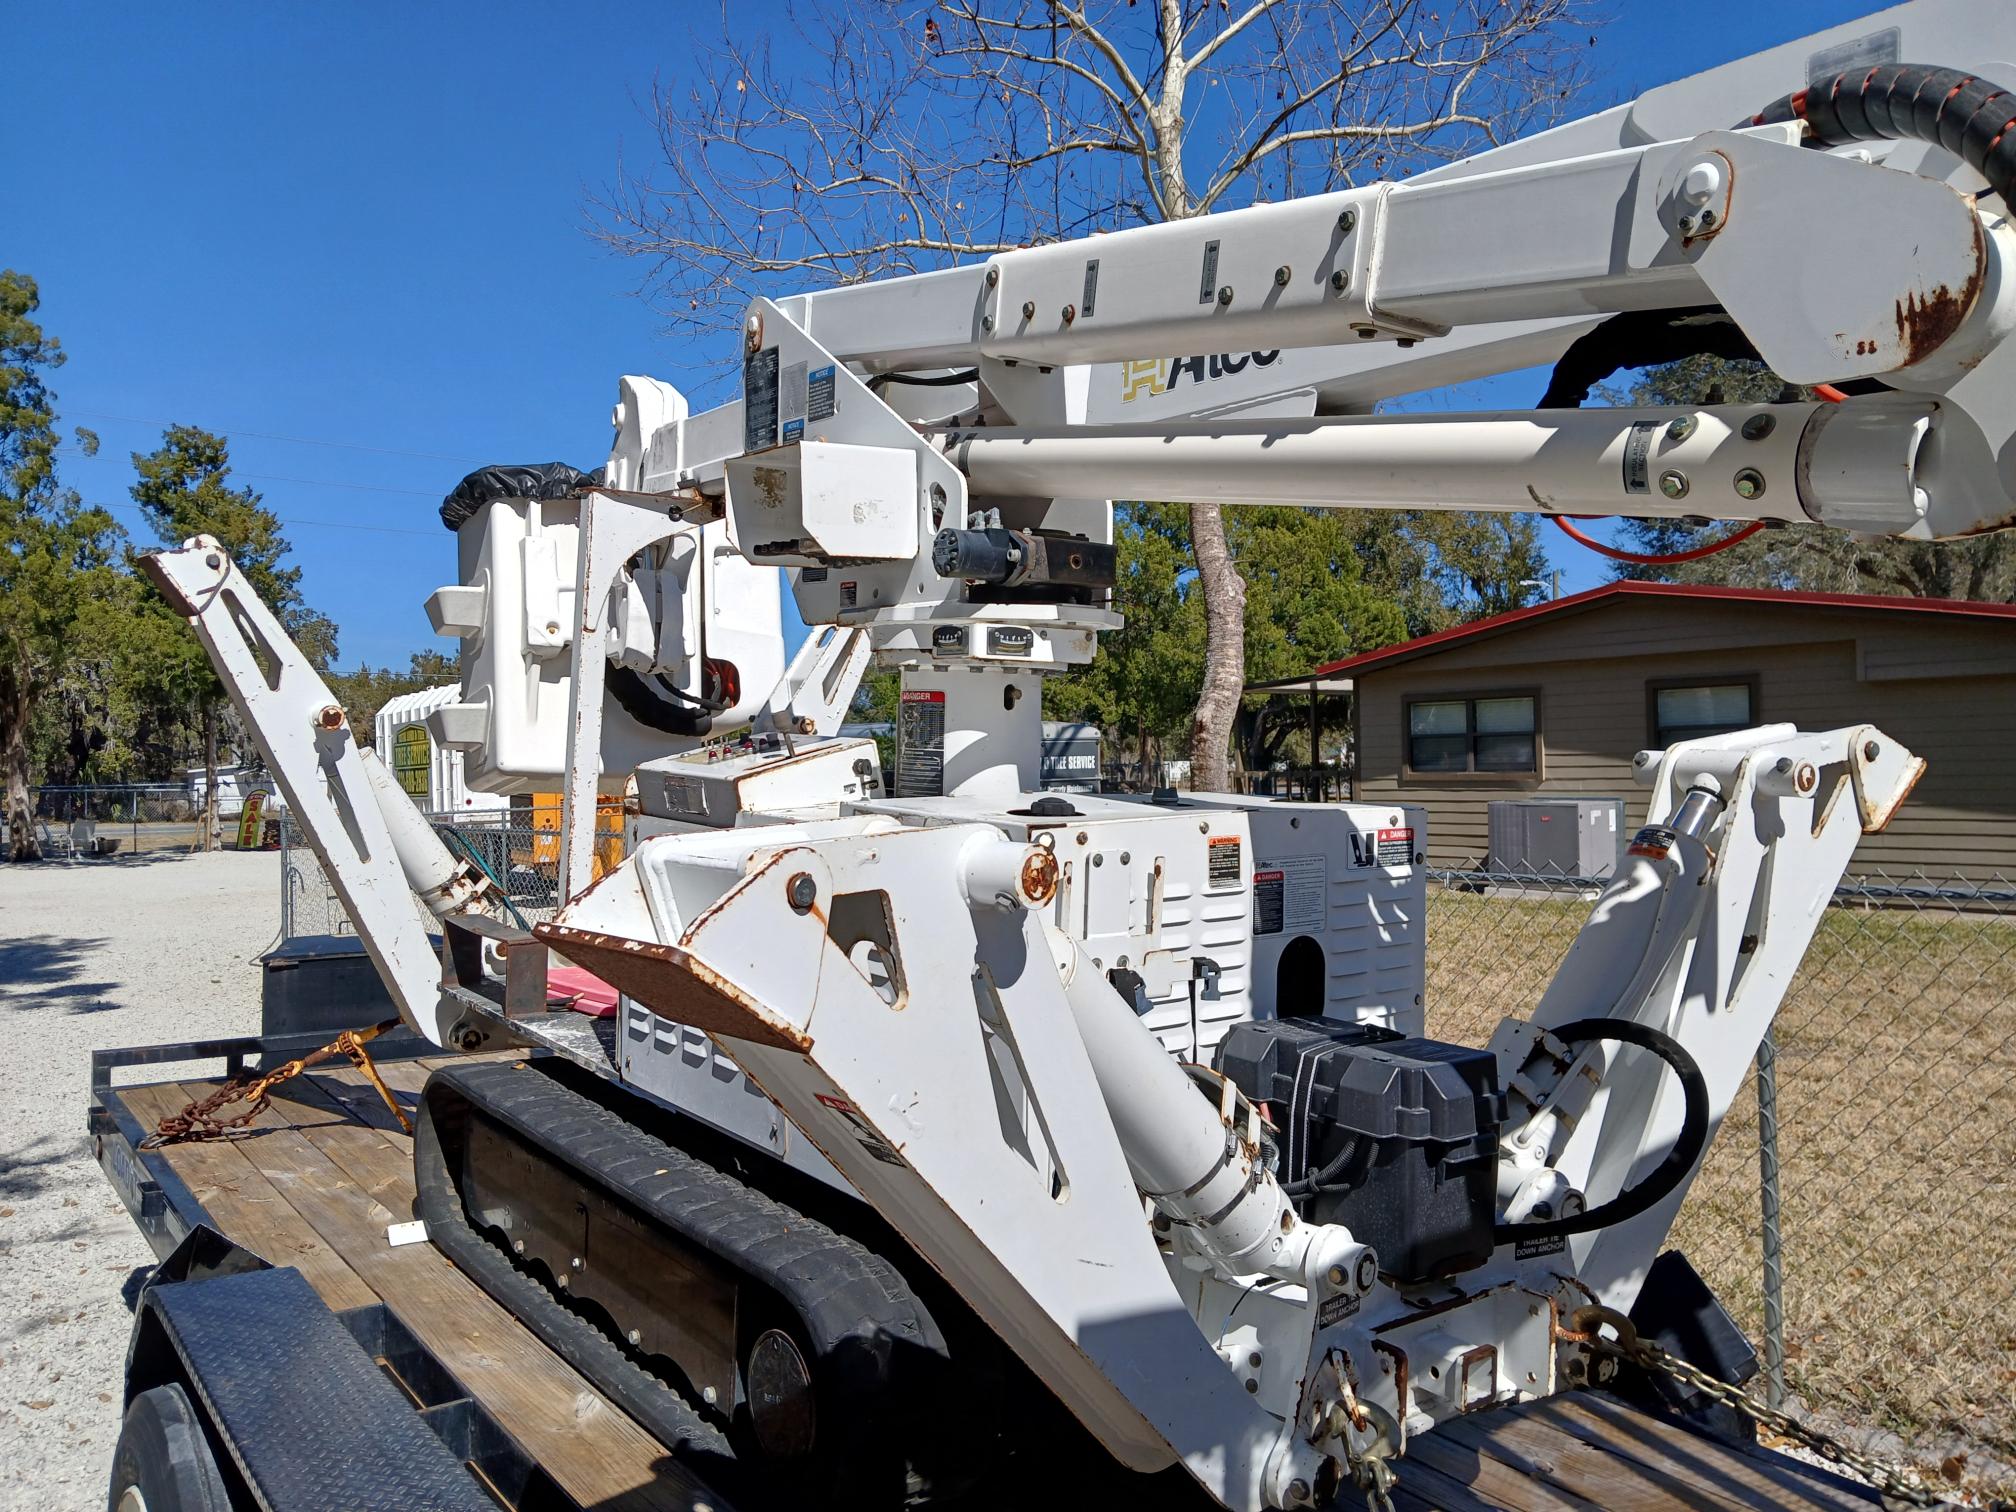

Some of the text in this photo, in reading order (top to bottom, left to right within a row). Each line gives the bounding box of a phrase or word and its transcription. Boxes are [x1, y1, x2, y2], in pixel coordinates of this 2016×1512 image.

[1068, 756, 1096, 769] SERVICE
[242, 800, 258, 846] SALE
[1390, 830, 1412, 839] DANGER
[1516, 1241, 1564, 1257] DOWN ANCHOR
[1320, 1300, 1360, 1325] DOWN ANCHOR
[1325, 1296, 1347, 1313] TRAILER
